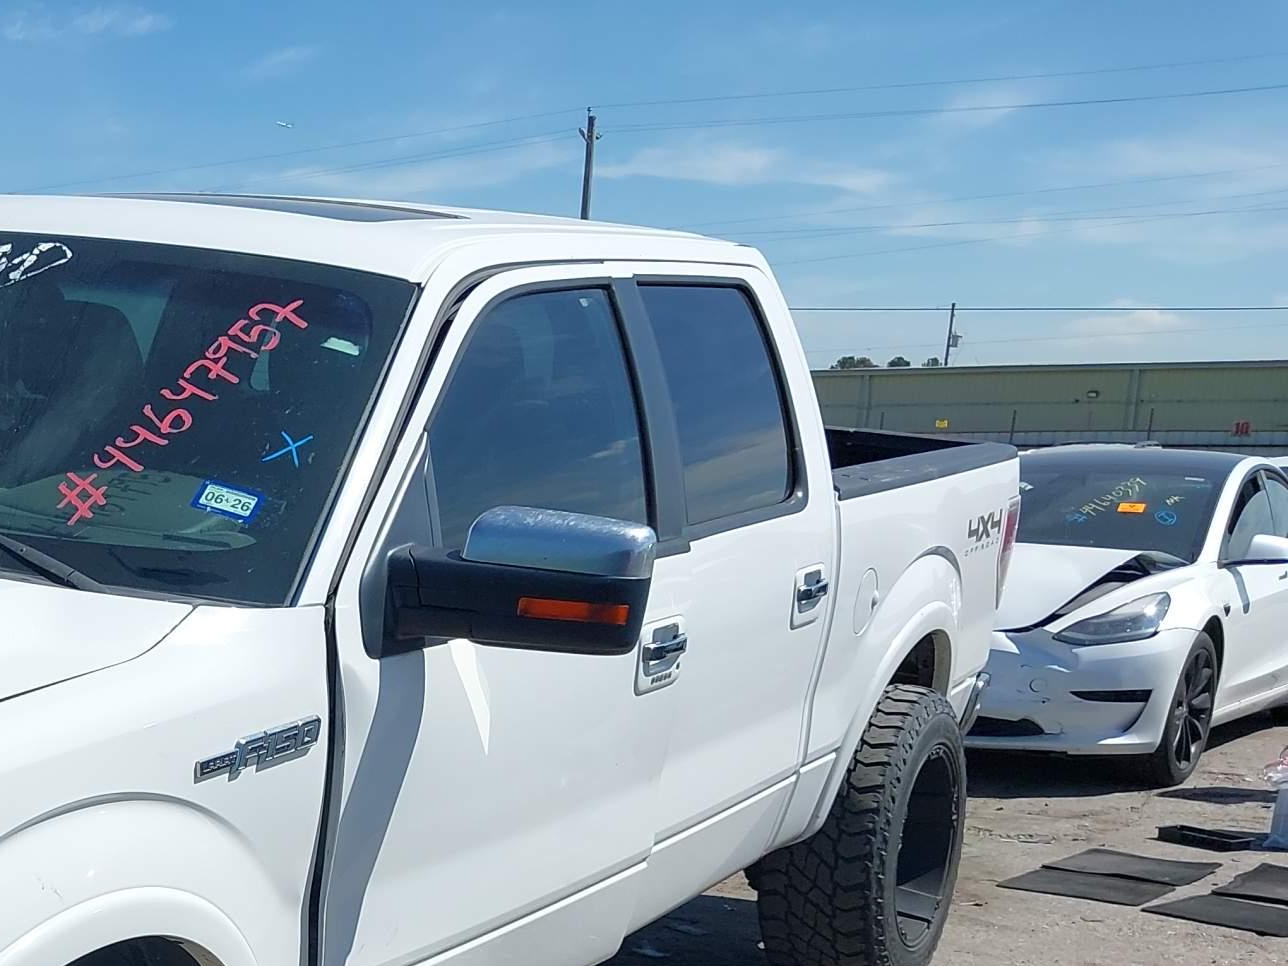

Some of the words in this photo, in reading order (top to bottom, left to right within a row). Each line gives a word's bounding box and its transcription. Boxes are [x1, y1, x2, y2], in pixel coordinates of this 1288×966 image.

[56, 299, 309, 526] #44647957
[204, 491, 226, 504] 06
[230, 498, 252, 512] 26
